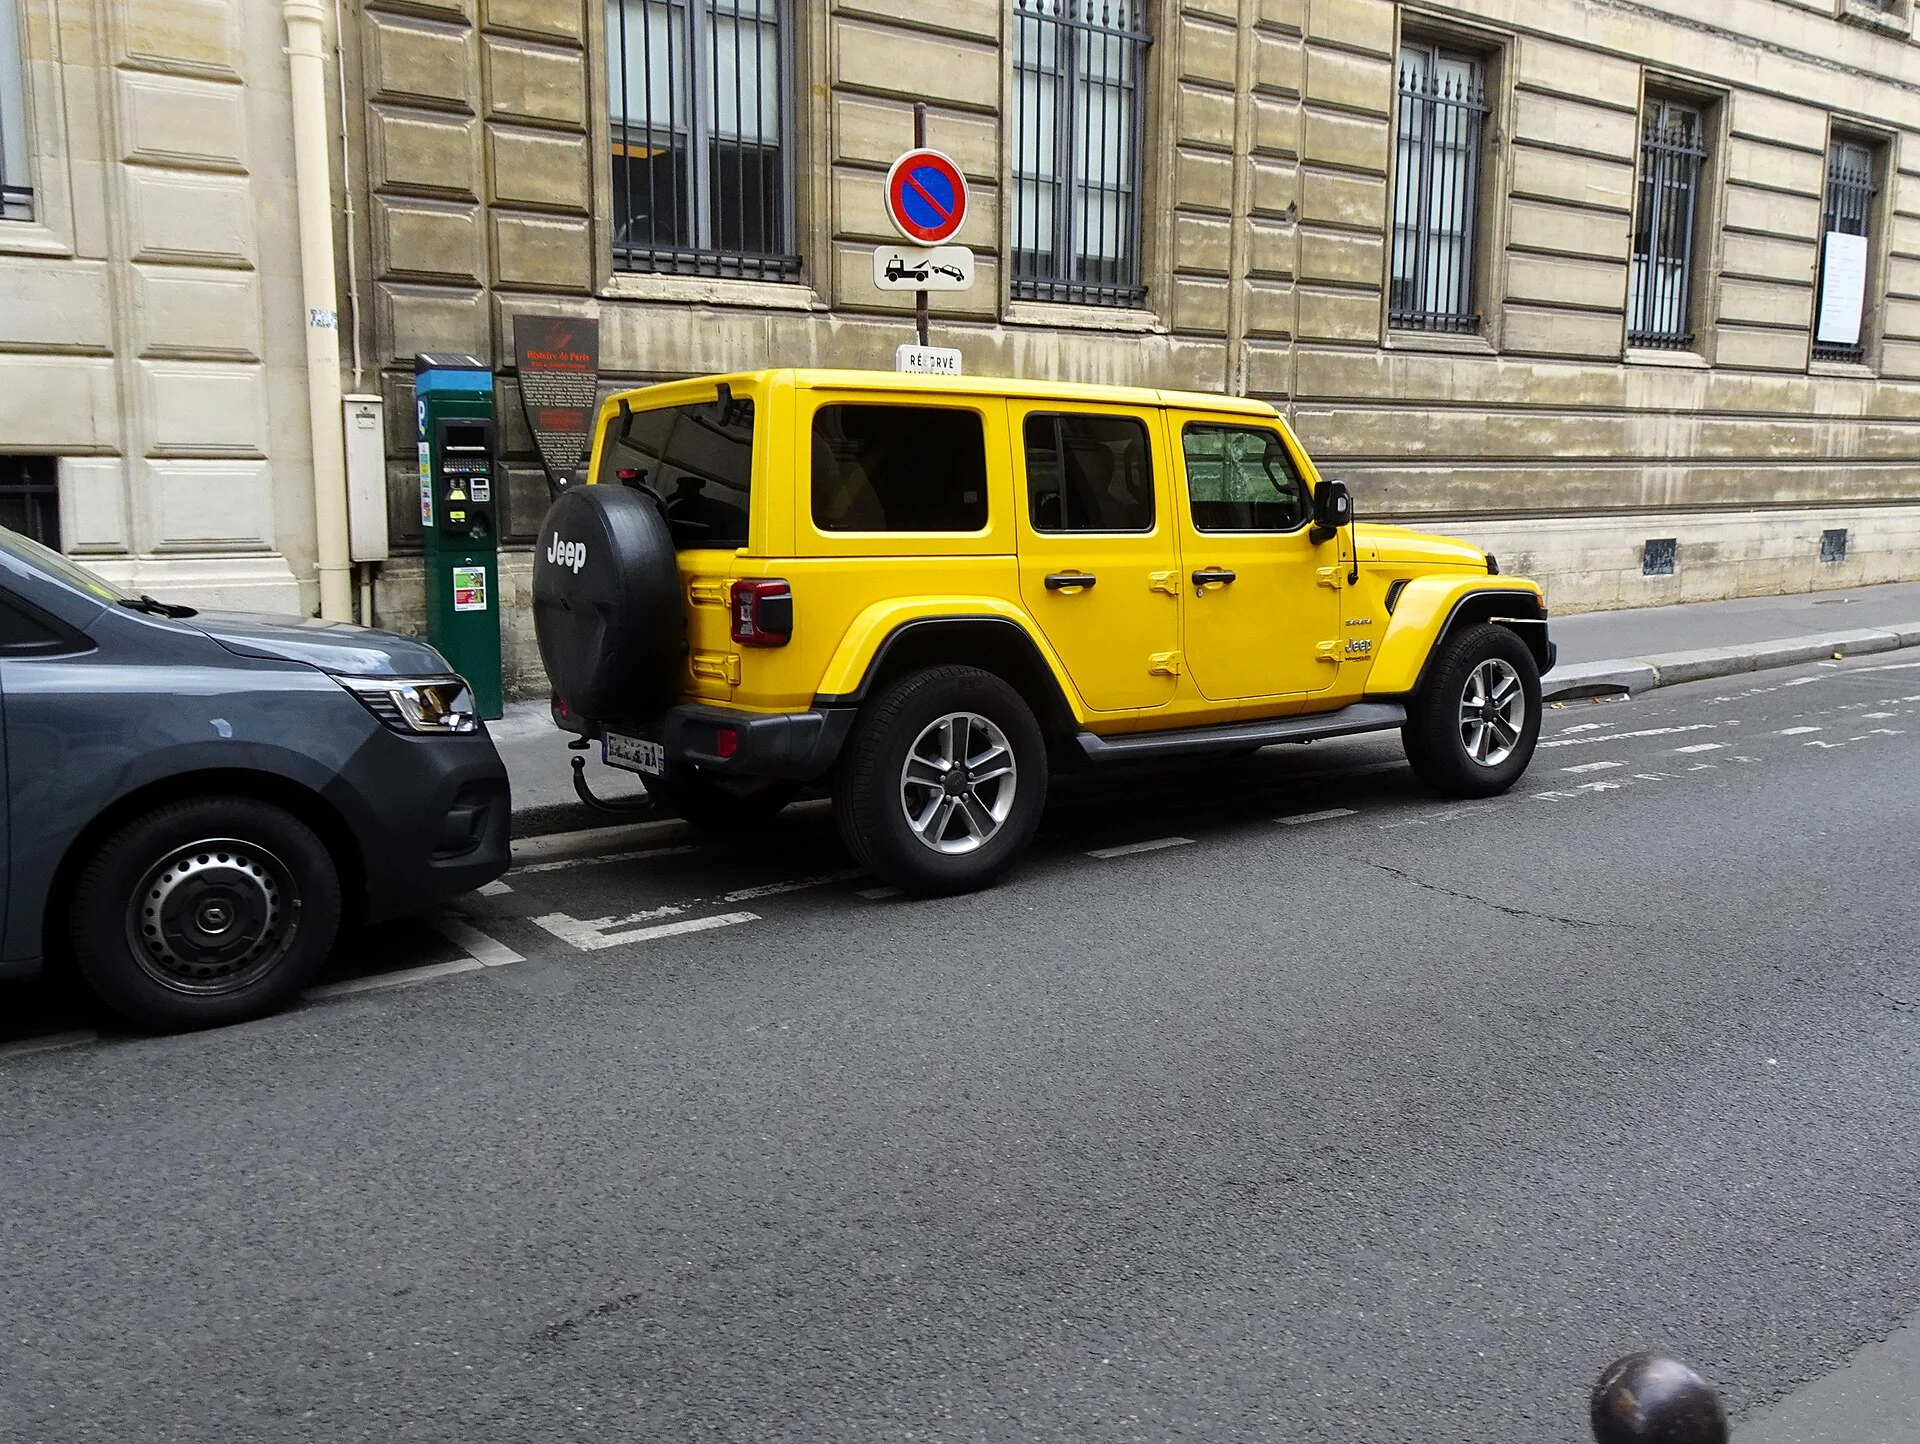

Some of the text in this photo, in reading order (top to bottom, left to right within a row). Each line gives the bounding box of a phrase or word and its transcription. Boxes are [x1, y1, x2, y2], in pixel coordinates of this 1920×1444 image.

[527, 350, 591, 362] Histoire de Paris
[910, 353, 954, 369] RÉERVÉ
[547, 531, 587, 574] Jeep
[1345, 637, 1372, 654] Jeep
